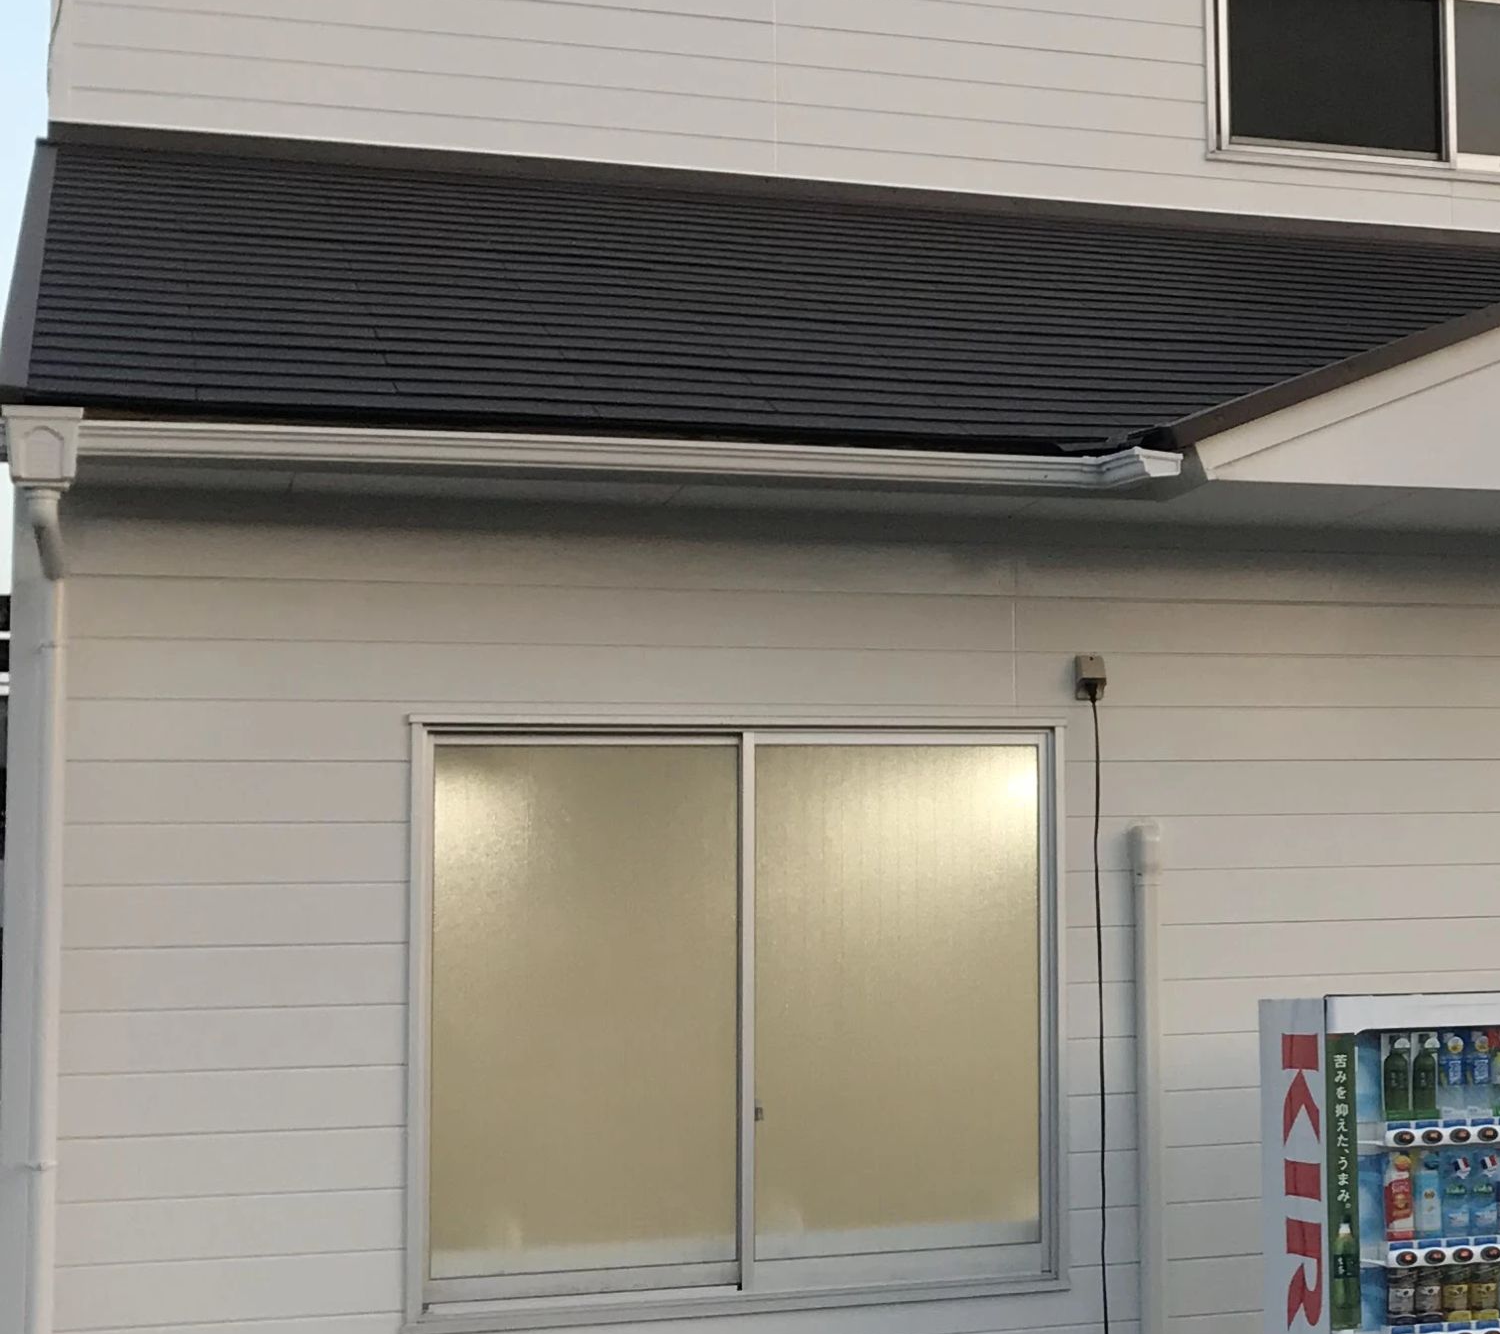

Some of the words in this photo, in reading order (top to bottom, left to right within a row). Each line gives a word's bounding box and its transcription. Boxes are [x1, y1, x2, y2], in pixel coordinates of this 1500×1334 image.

[1333, 1054, 1352, 1208] 苦みを抑えた、うまみ。
